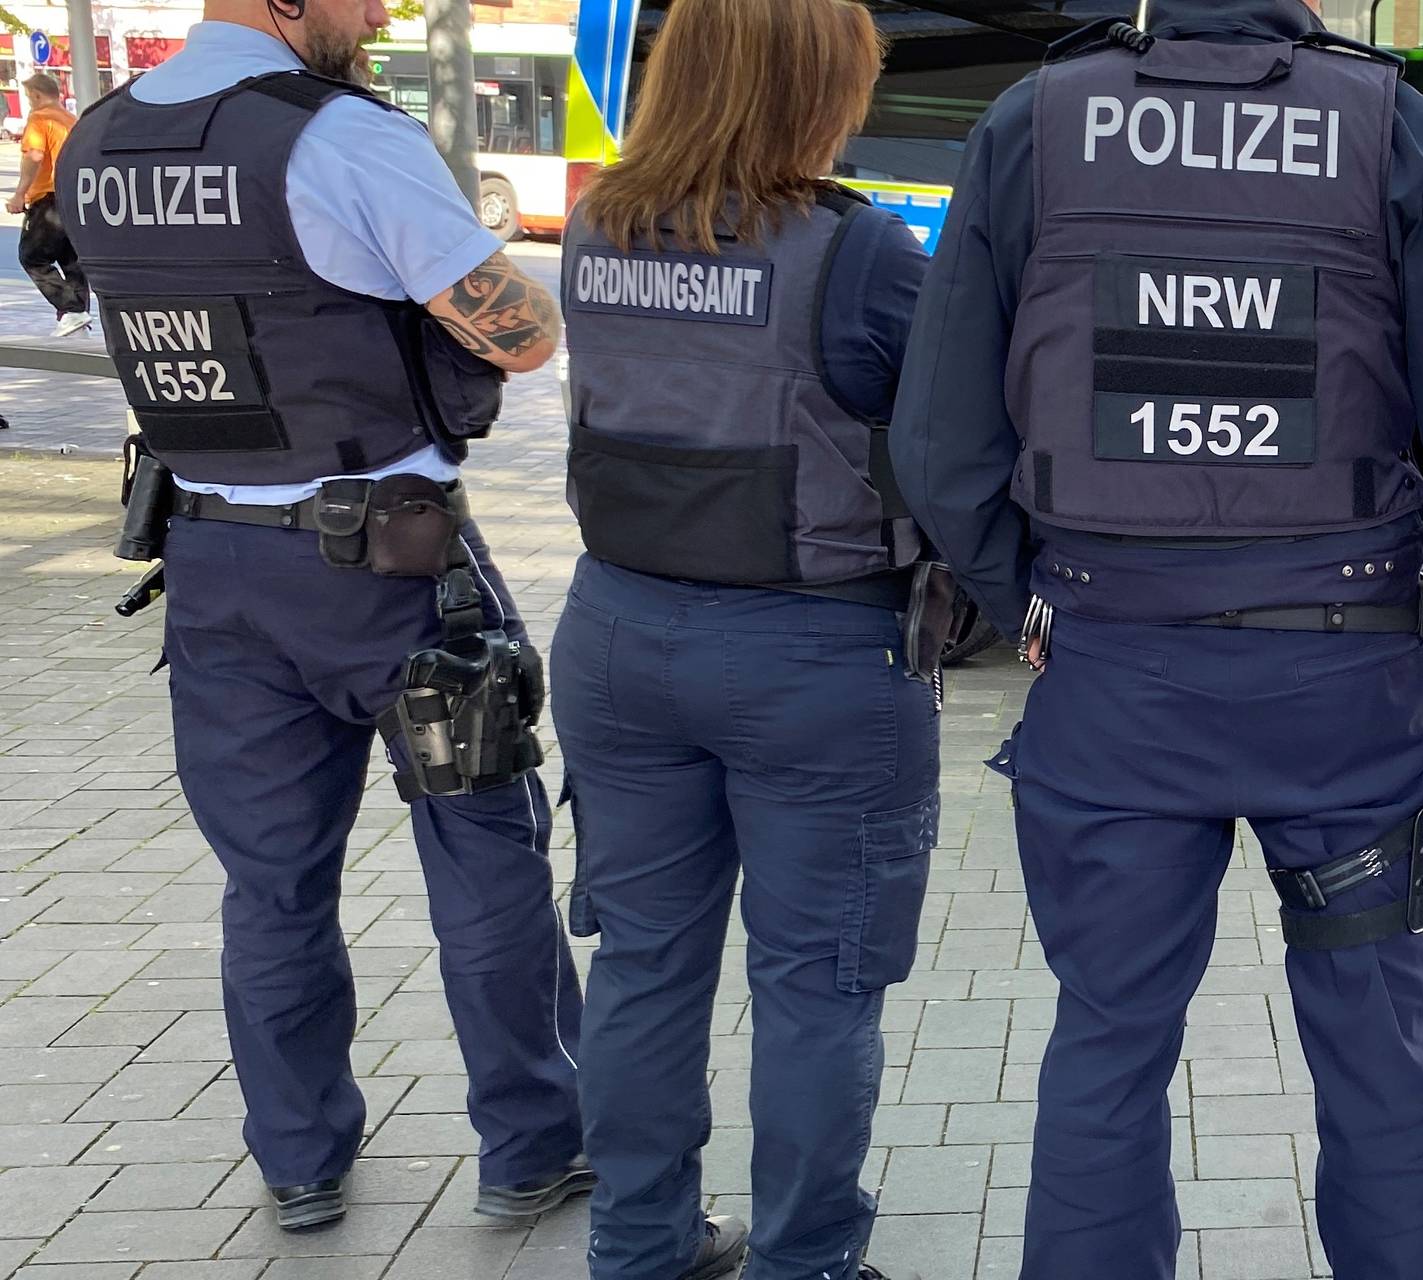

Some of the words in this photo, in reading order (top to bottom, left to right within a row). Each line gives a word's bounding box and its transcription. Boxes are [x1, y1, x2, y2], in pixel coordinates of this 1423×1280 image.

[1084, 96, 1340, 178] POLIZEI
[77, 165, 241, 226] POLIZEI
[576, 255, 763, 317] ORDNUNGSAMT
[1138, 272, 1282, 330] NRW
[119, 310, 213, 352] NRW
[134, 360, 235, 402] 1552
[1130, 401, 1280, 457] 1552
